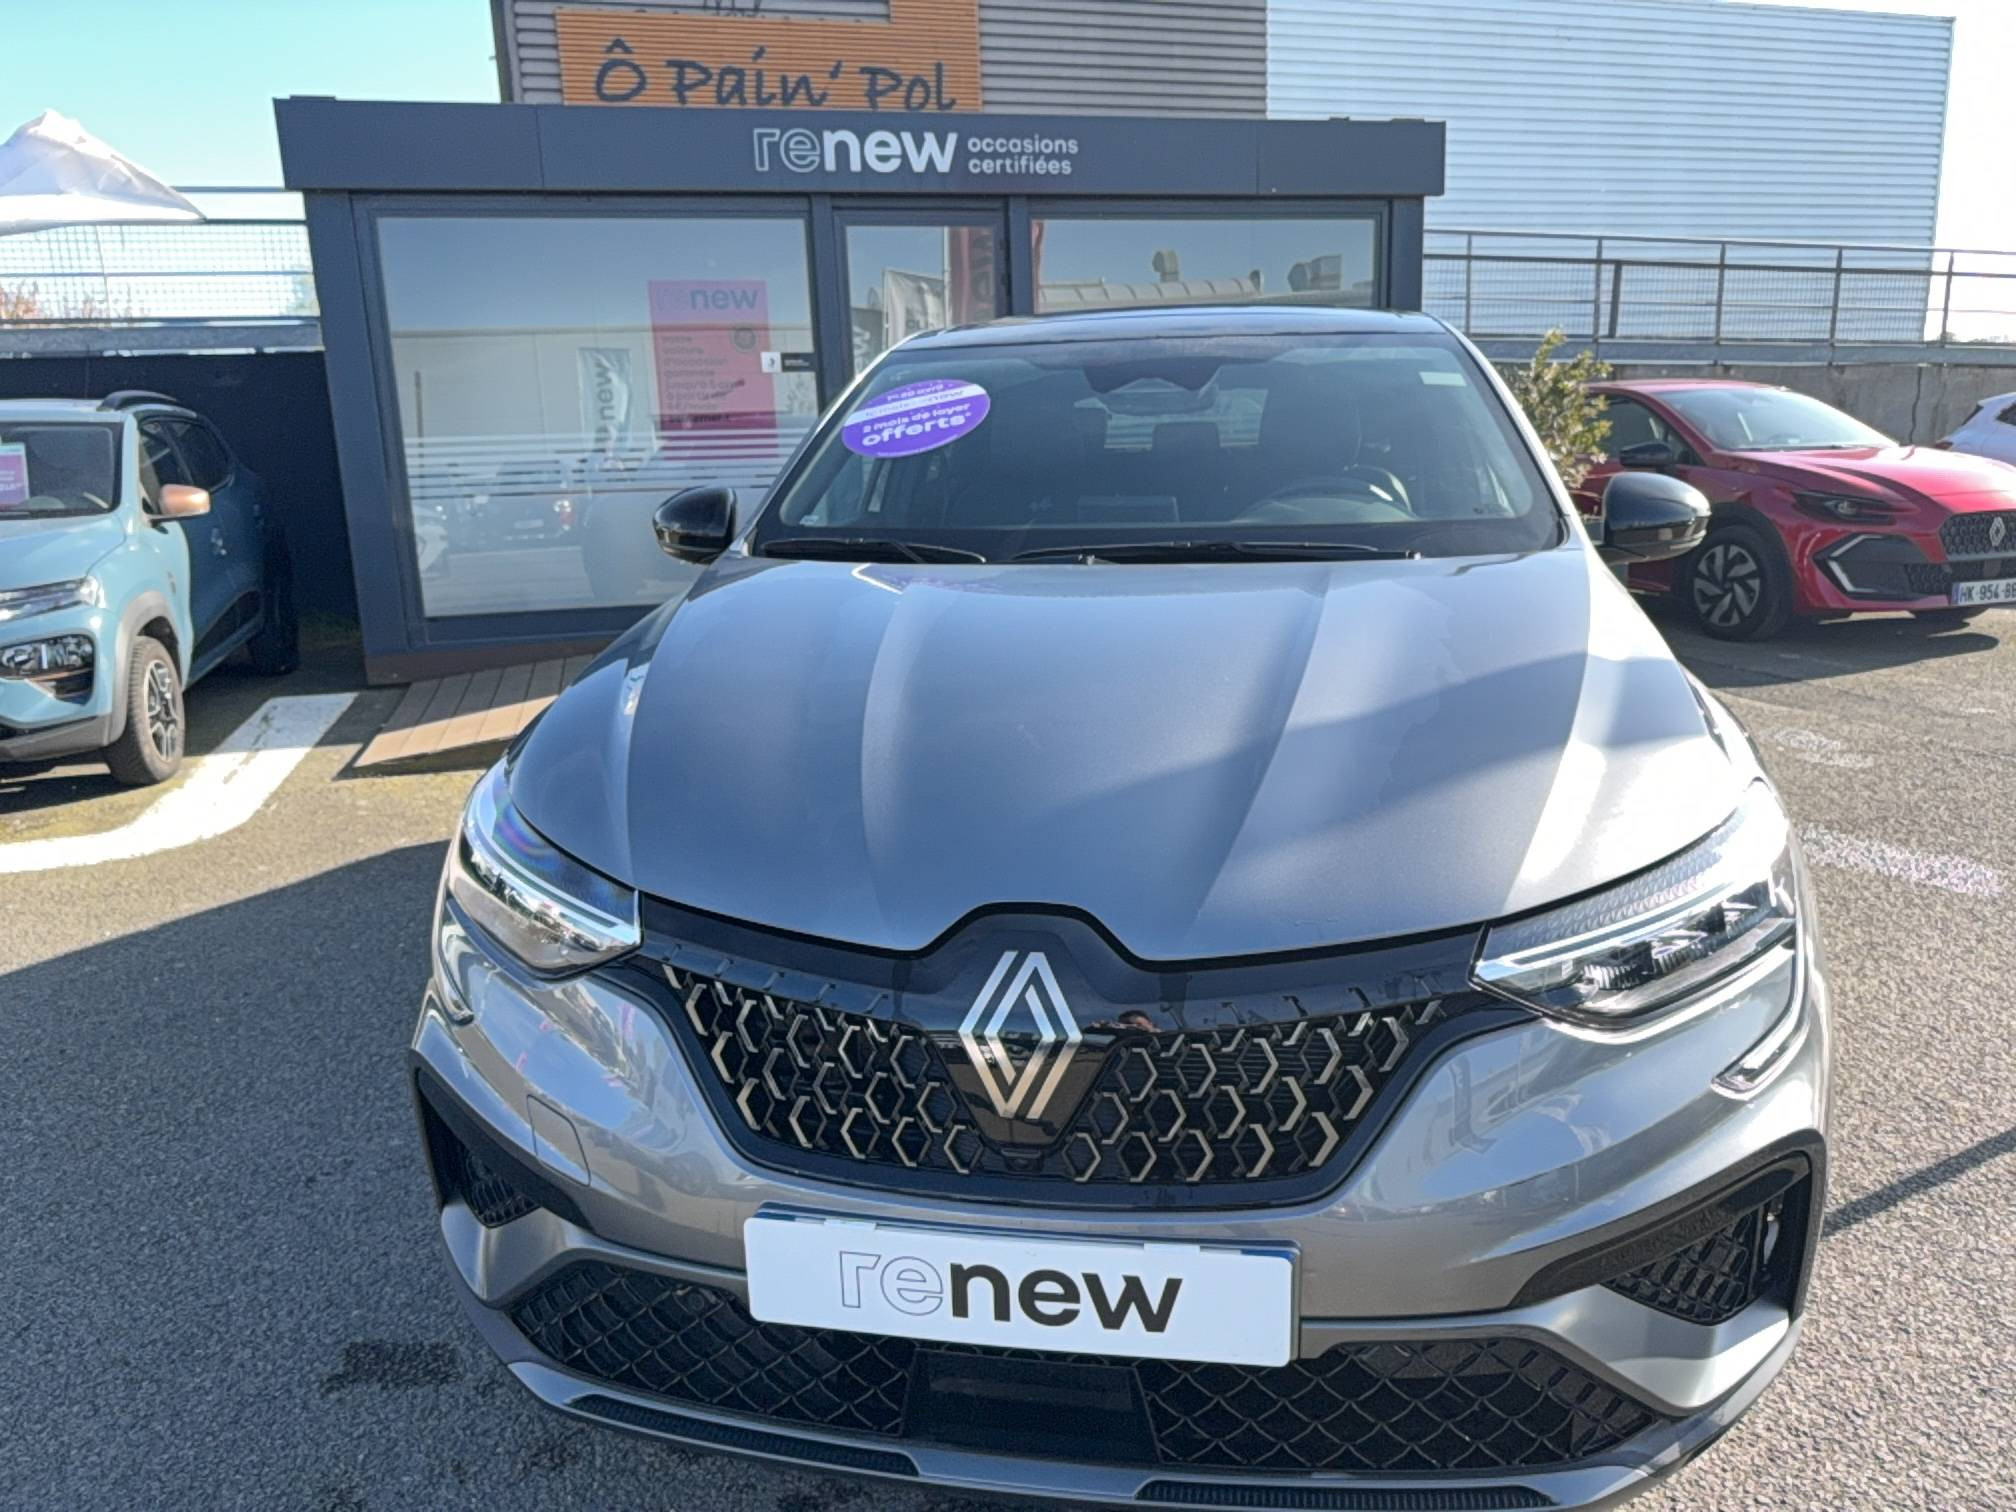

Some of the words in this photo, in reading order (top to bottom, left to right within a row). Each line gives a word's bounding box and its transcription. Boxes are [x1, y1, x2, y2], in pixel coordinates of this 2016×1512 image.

[595, 38, 647, 103] Ô
[859, 61, 957, 112] Pol
[753, 127, 959, 174] renew
[967, 136, 1079, 156] occasions
[967, 155, 1073, 175] certifiées
[838, 1250, 1183, 1333] renew
